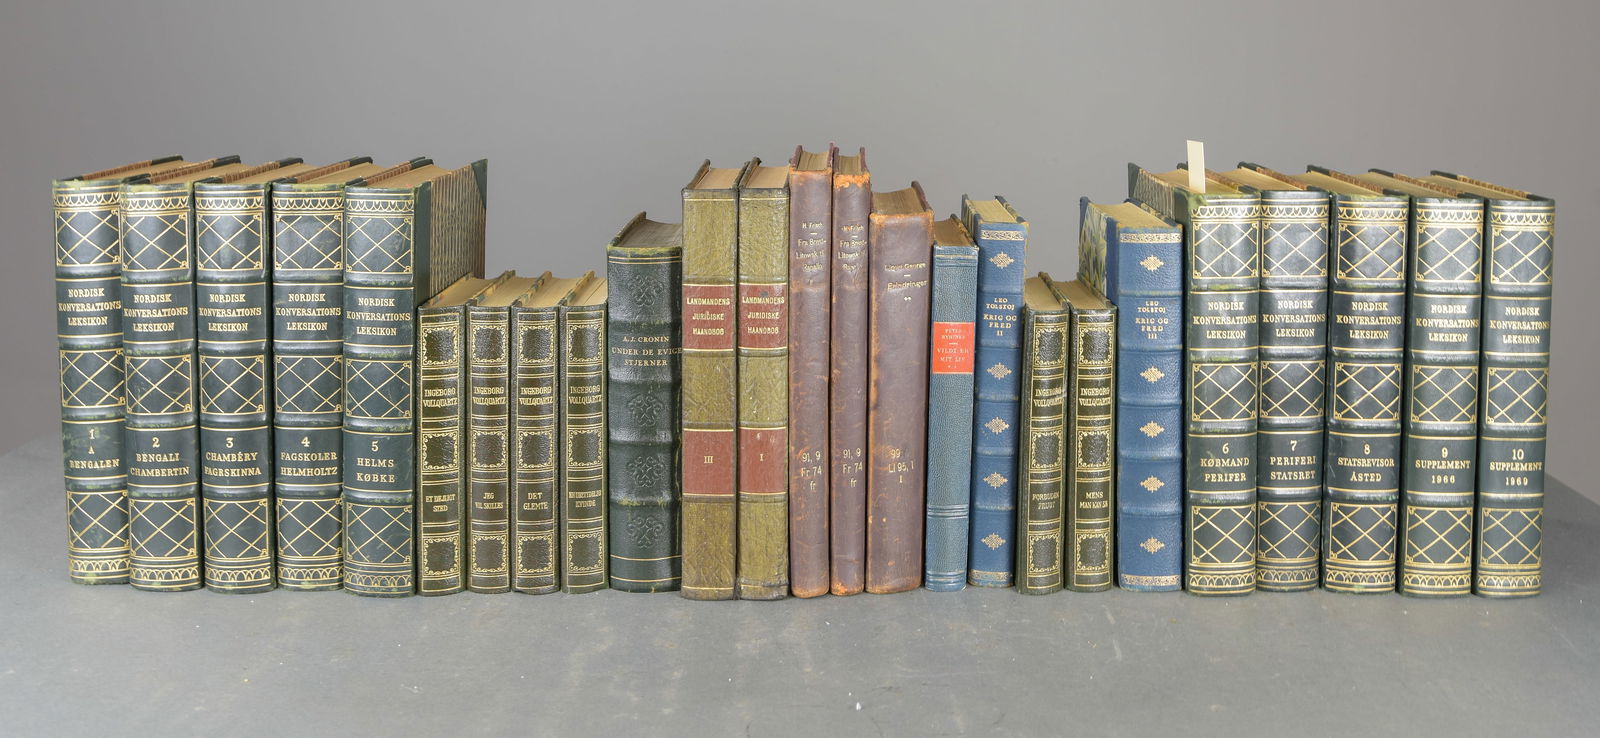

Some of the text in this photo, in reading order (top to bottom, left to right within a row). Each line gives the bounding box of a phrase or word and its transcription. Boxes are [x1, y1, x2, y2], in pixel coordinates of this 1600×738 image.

[69, 289, 105, 298] NORDISK
[134, 293, 172, 303] NORDISK
[210, 293, 246, 303] NORDISK
[288, 293, 326, 302] NORDISK
[359, 298, 395, 307] NORDISK
[742, 296, 784, 304] LANDMANDENS
[1278, 300, 1313, 309] NORDISK
[58, 301, 121, 311] KONVERSATIONS
[1208, 301, 1244, 311] NORDISK
[1352, 302, 1388, 311] NORDISK
[1431, 304, 1466, 314] NORDISK
[124, 307, 188, 318] KONVERSATIONS
[200, 307, 261, 317] KONVERSATIONS
[276, 307, 341, 316] KONVERSATIONS
[347, 312, 410, 321] KONVERSATIONS
[1505, 307, 1540, 316] NORDISK
[68, 316, 107, 326] LEKSIKON
[1194, 315, 1257, 325] KONVERSATIONS
[1263, 314, 1325, 323] KONVERSATIONS
[1337, 315, 1401, 325] KONVERSATIONS
[1416, 318, 1479, 328] KONVERSATIONS
[133, 323, 174, 332] LEKSIKON
[208, 323, 248, 332] LEKSIKON
[287, 322, 327, 331] LEKSIKON
[1490, 320, 1550, 329] KONVERSATIONS
[357, 326, 397, 336] LEKSIKON
[1207, 330, 1246, 339] LEKSIKON
[1276, 328, 1314, 337] LEKSIKON
[1350, 330, 1389, 339] LEKSIKON
[1429, 333, 1468, 342] LEKSIKON
[1503, 334, 1540, 344] LEKSIKON
[612, 347, 639, 355] UNDER
[425, 389, 456, 397] INGEBORG
[521, 387, 552, 395] INGEBORG
[570, 385, 600, 393] INGEBORG
[1035, 387, 1062, 396] INGEBORG
[1081, 387, 1110, 396] INGEBORG
[423, 398, 457, 408] VOLLQUARTZ
[473, 397, 506, 405] VOLLQUARTZ
[519, 396, 553, 406] VOLLQUARTZ
[569, 395, 602, 405] VOLLQUARTZ
[89, 430, 94, 440] 1
[152, 437, 160, 448] 2
[226, 437, 233, 448] 3
[302, 437, 310, 447] 4
[372, 441, 378, 452] 5
[1291, 441, 1297, 451] 7
[1222, 443, 1229, 454] 6
[1364, 444, 1370, 454] 8
[1442, 447, 1448, 459] 9
[136, 452, 179, 463] BENGALI
[206, 450, 258, 461] CHAMBÉRY
[281, 452, 337, 461] FAGSKOLER
[1512, 449, 1524, 460] 10
[70, 459, 119, 469] BENGALEN
[357, 458, 394, 467] HELMS
[1201, 457, 1249, 468] KØBMAND
[1270, 456, 1316, 465] PERIFERI
[1338, 458, 1394, 467] STATSREVISOR
[1415, 460, 1470, 469] SUPPLEMENT
[281, 467, 338, 476] HELMHOLTZ
[813, 466, 822, 476] 74
[855, 462, 862, 473] 74
[1490, 462, 1542, 471] SUPPLEMENT
[130, 467, 190, 477] CHAMBERTIN
[205, 467, 261, 477] FAGRSKINNA
[357, 472, 395, 482] KØBKE
[1205, 472, 1246, 482] PERIFER
[1271, 470, 1315, 480] STATSRET
[1351, 471, 1382, 482] ÅSTED
[1431, 474, 1455, 484] 1966
[1505, 477, 1528, 486] 1969
[523, 502, 548, 510] GLEMTE
